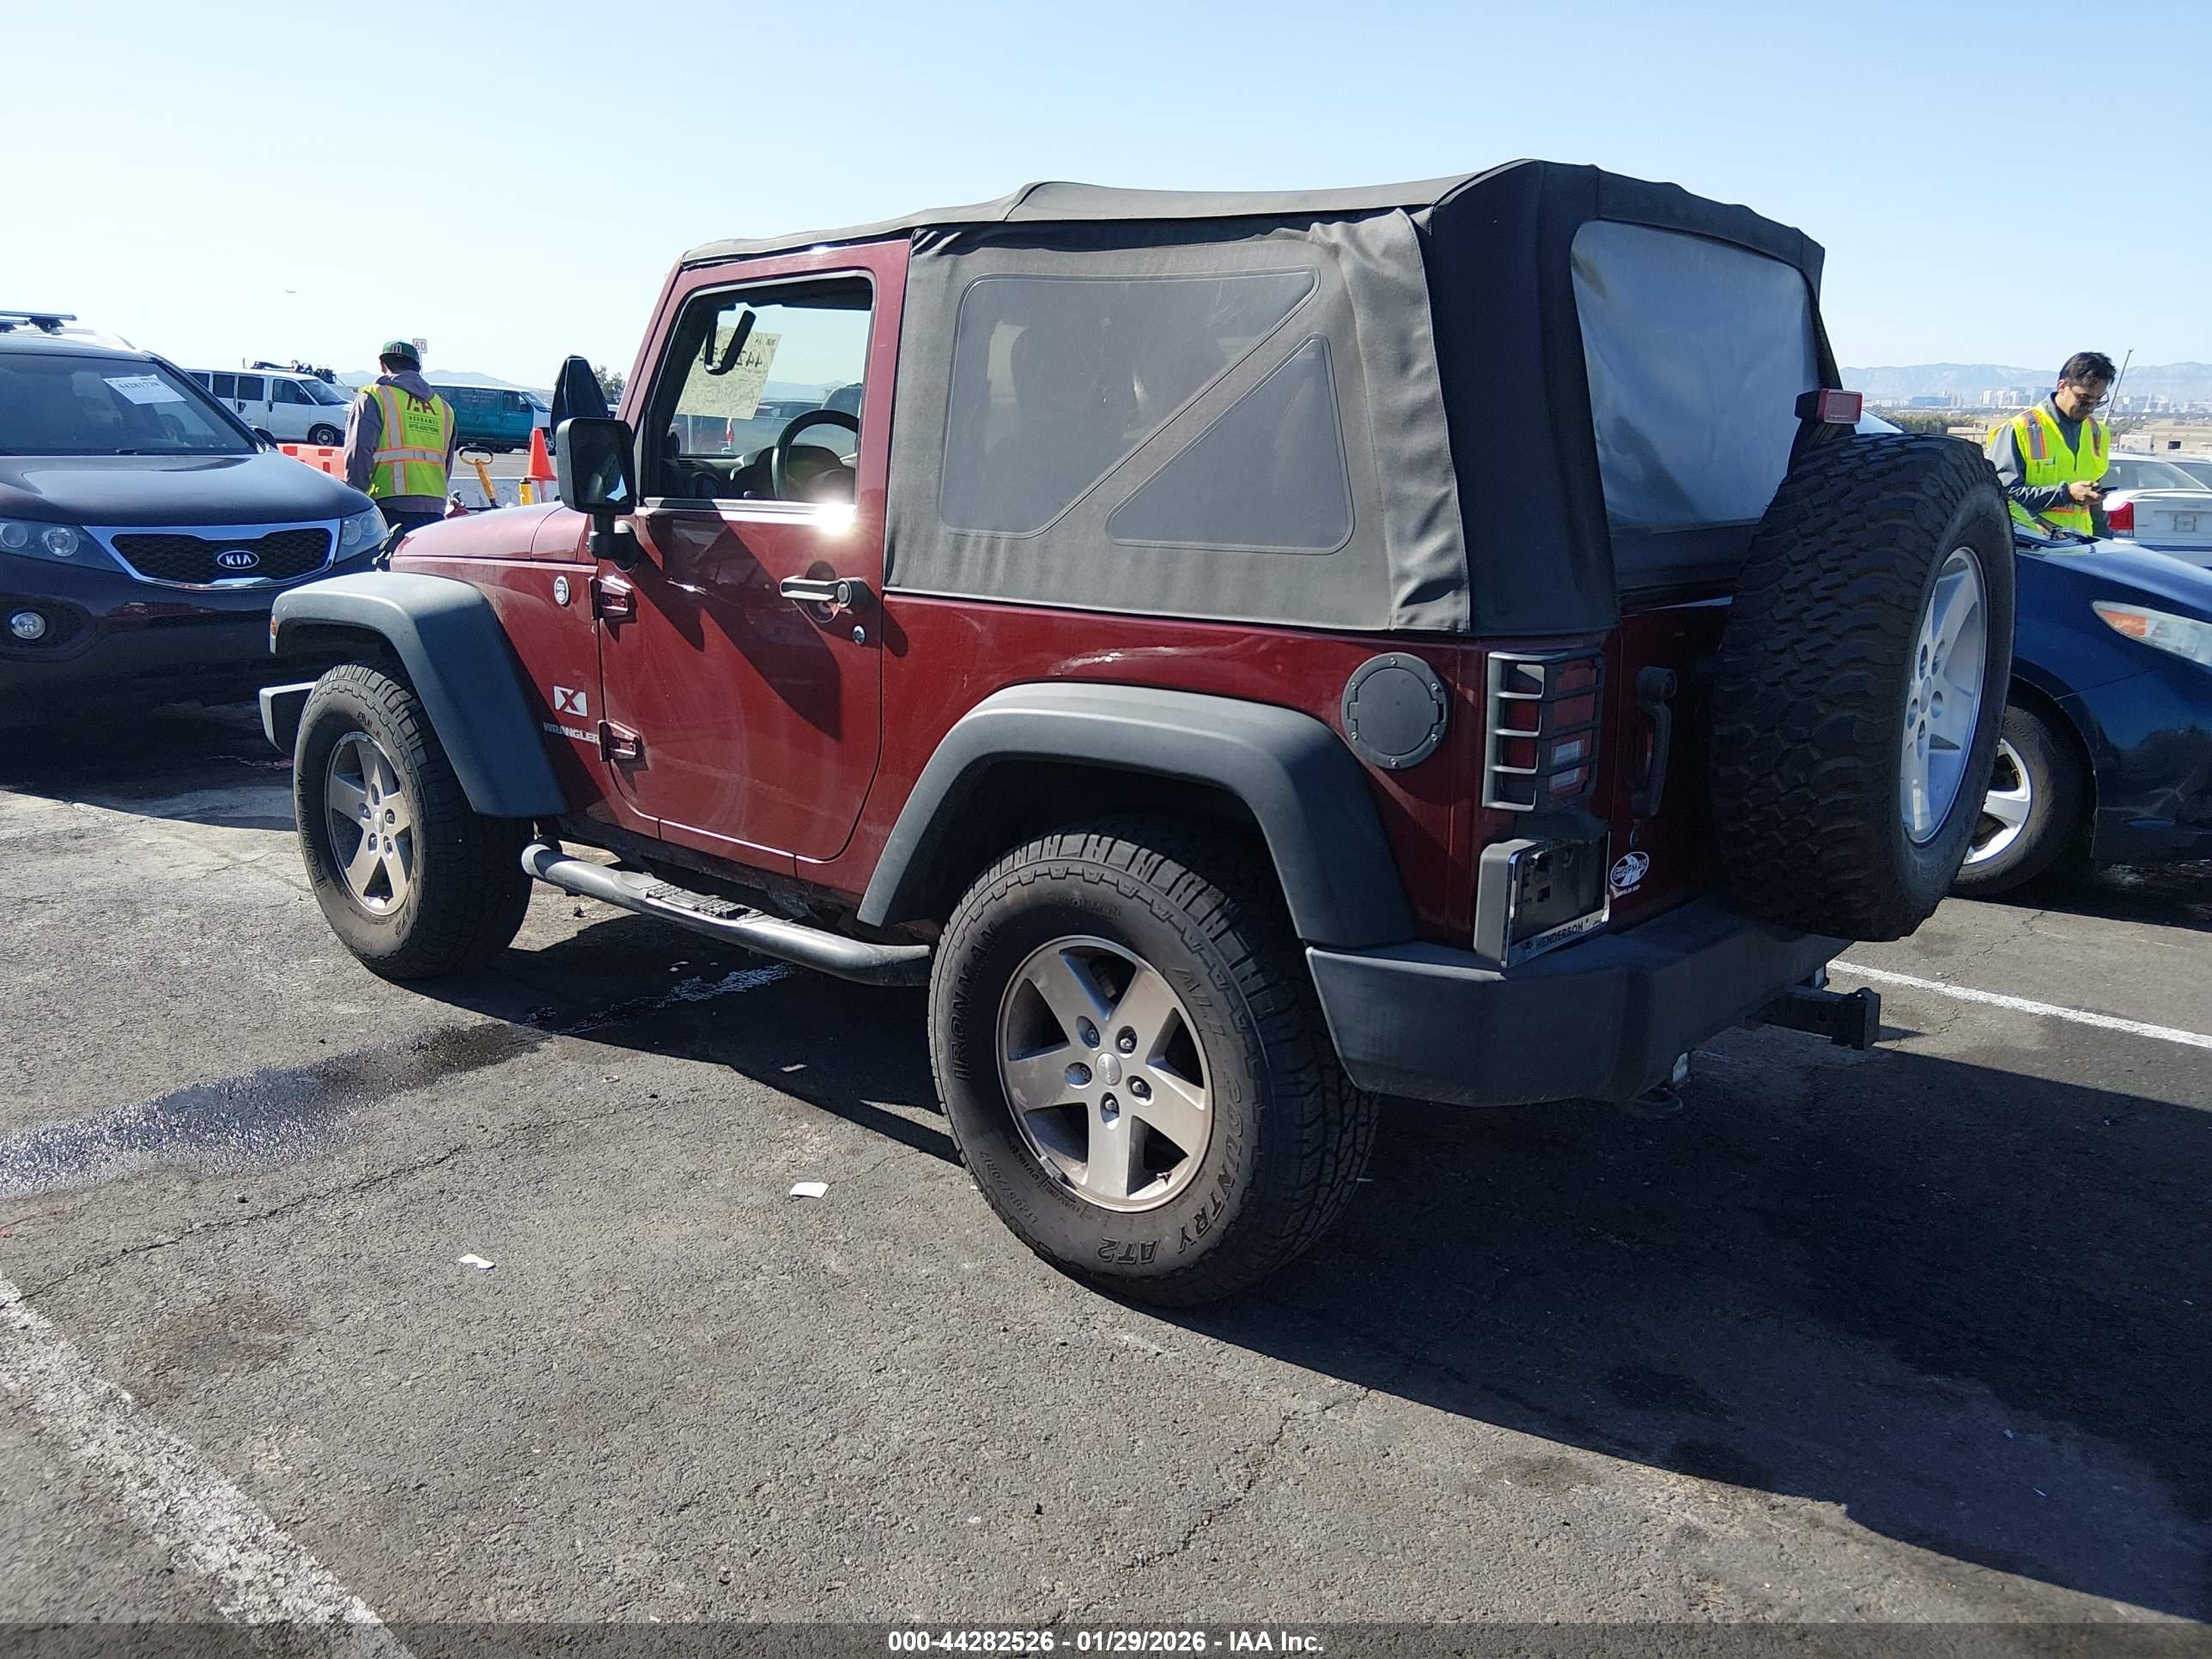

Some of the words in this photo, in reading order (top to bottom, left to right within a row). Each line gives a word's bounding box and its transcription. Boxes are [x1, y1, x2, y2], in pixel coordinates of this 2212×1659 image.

[225, 554, 252, 565] KIA
[1536, 921, 1584, 949] HENDERSON
[950, 921, 999, 1080] IRONMAN
[1177, 1071, 1244, 1255] COUNTRY
[1097, 1237, 1161, 1265] AT2
